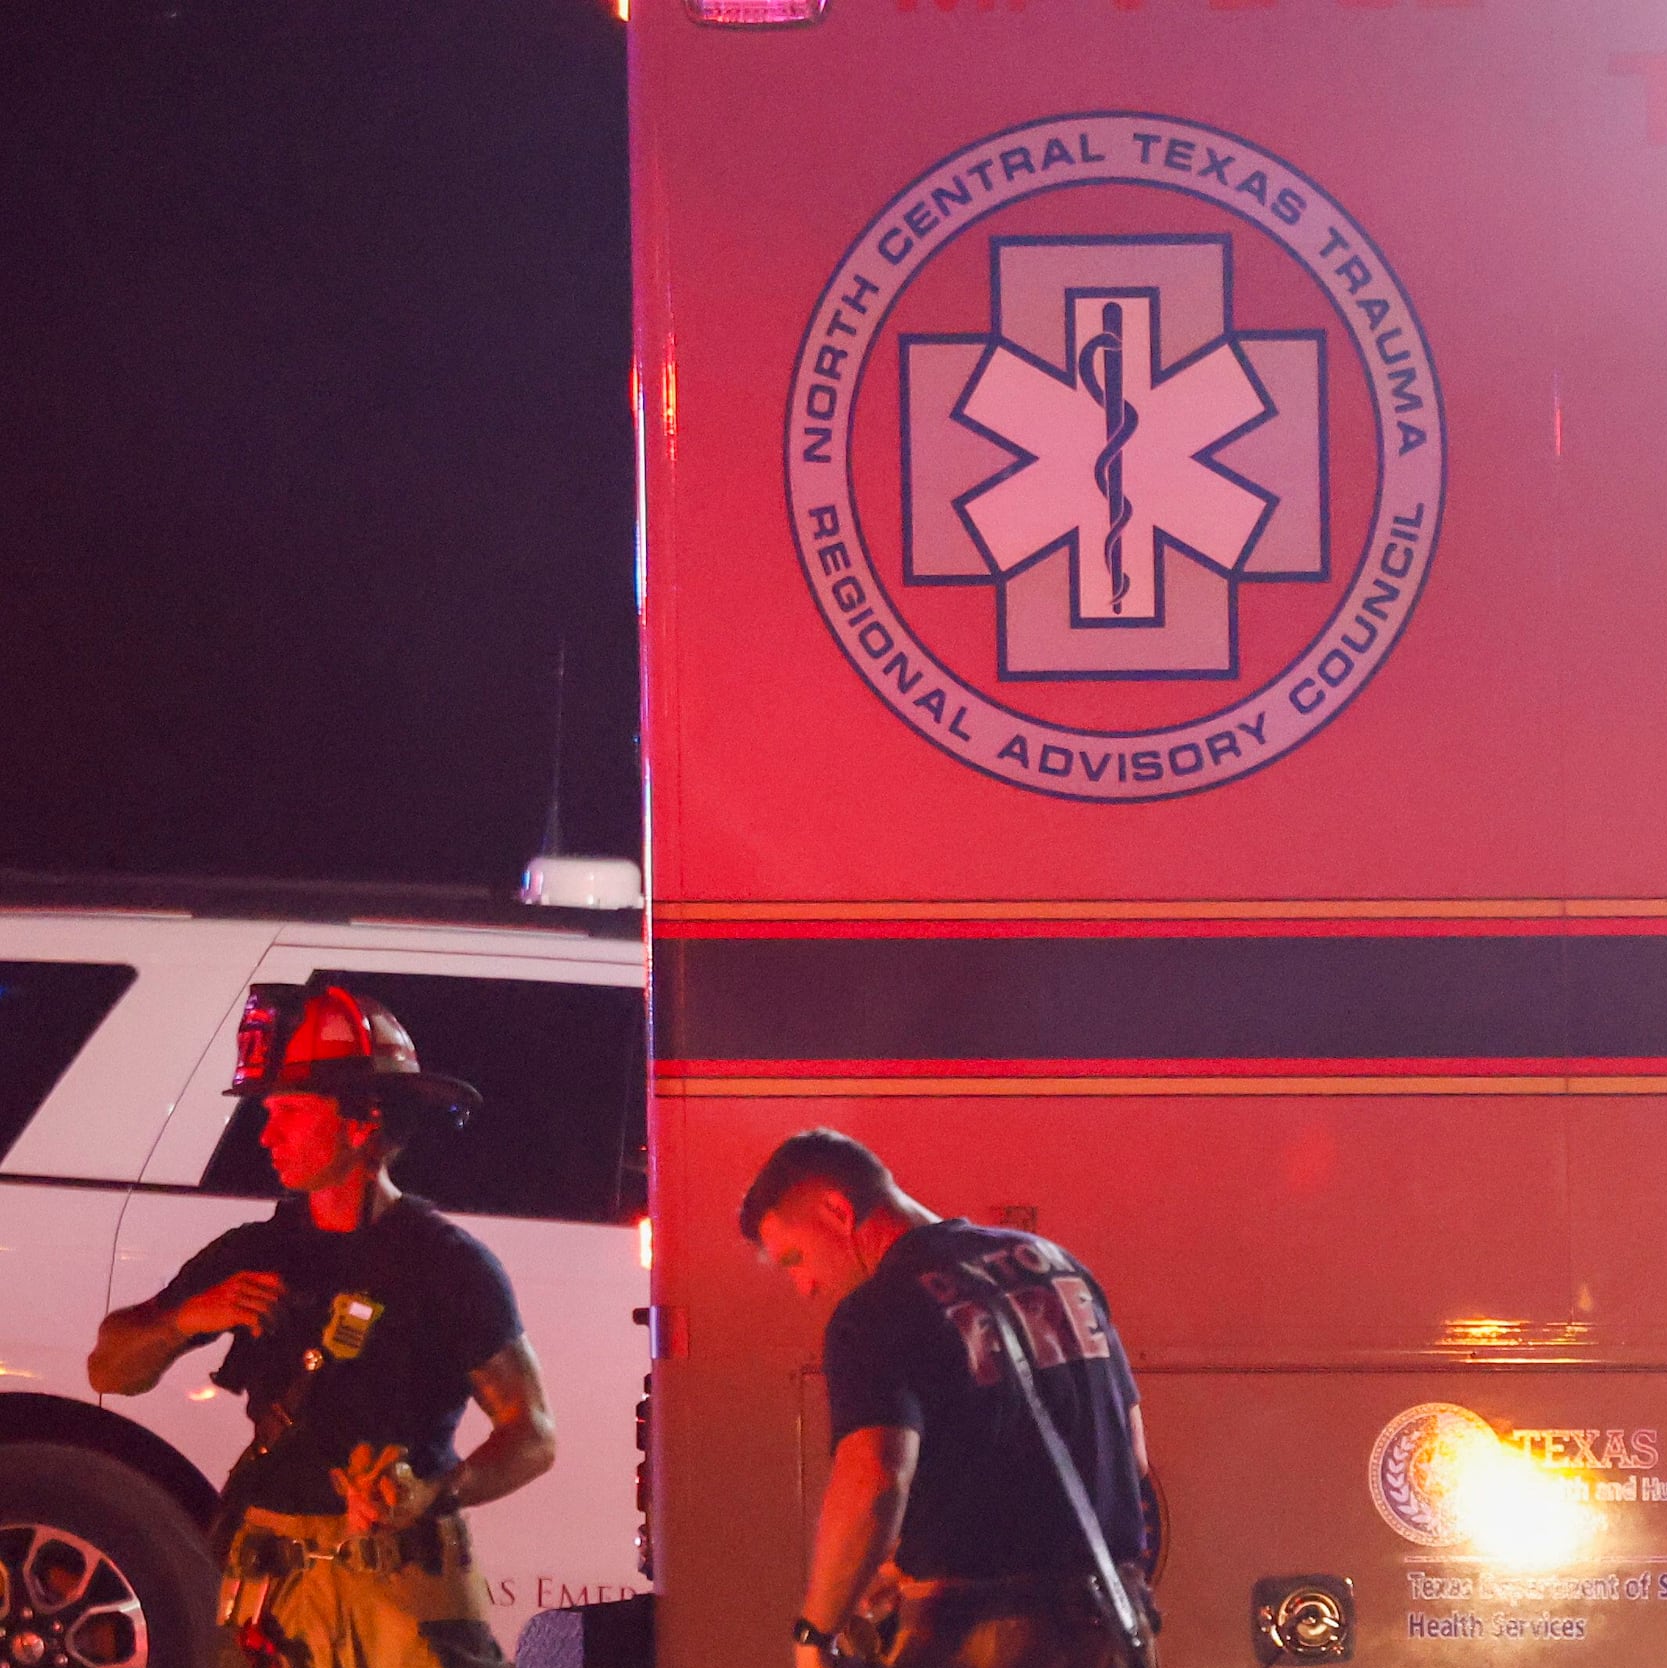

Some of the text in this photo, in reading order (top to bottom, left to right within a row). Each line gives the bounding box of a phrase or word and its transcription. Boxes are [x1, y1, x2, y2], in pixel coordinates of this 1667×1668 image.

[803, 132, 1427, 465] NORTH CENTRAL TEXAS TRAUMA
[808, 500, 1426, 785] REGIONAL ADVISORY COUNCIL
[1513, 1428, 1660, 1470] TEXAS
[1407, 1571, 1473, 1600] Texas
[1625, 1572, 1651, 1600] of
[1407, 1610, 1586, 1639] Health Services
